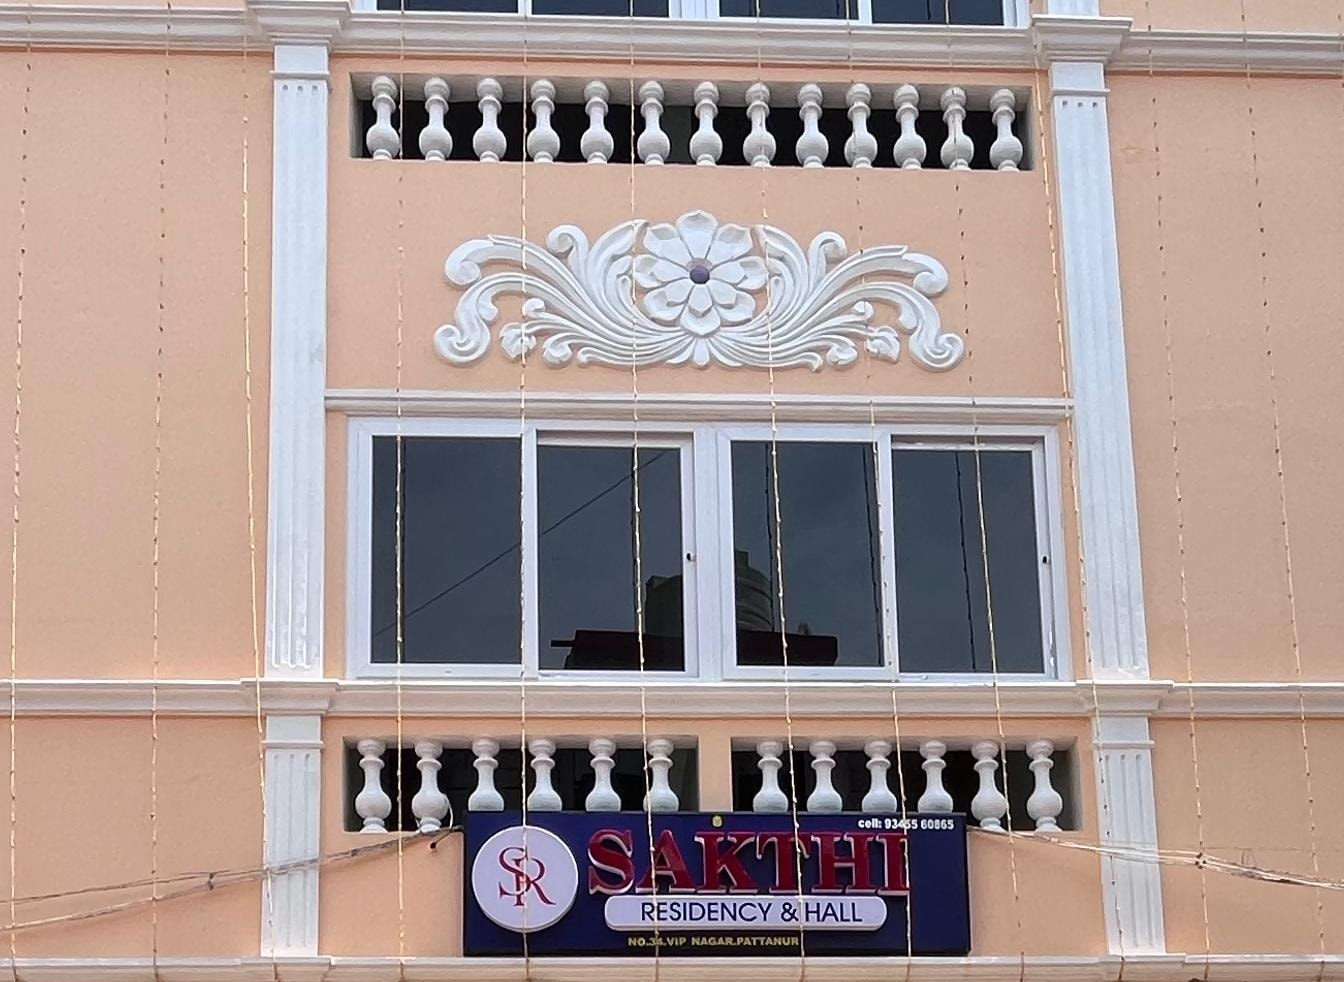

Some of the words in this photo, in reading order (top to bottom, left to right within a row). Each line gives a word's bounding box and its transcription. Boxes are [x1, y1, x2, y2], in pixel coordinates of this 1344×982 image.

[858, 818, 882, 829] cell:
[920, 819, 955, 830] 60865
[587, 829, 910, 895] SAKTHI
[641, 902, 779, 922] RESIDENCY
[780, 902, 799, 922] &
[805, 902, 862, 922] HALL
